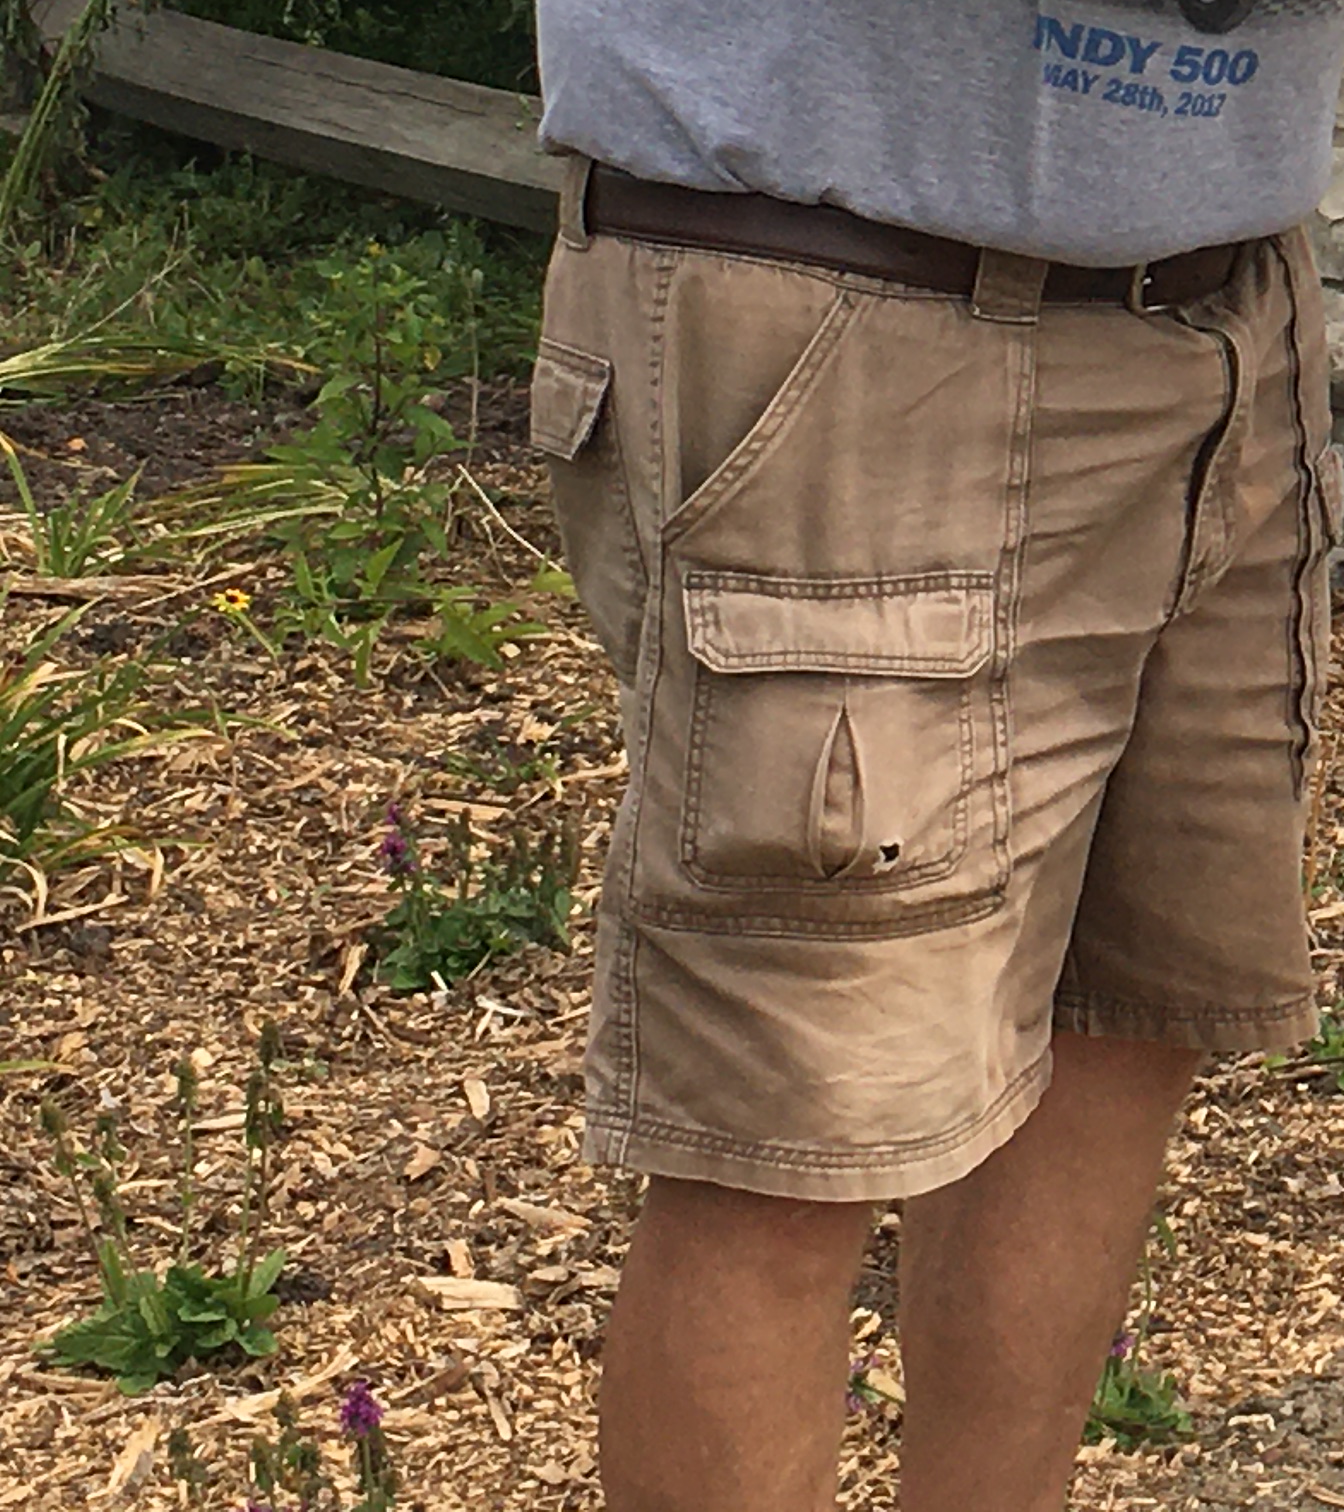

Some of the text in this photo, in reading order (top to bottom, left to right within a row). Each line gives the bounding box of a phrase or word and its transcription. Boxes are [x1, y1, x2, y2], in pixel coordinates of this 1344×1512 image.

[1168, 44, 1259, 86] 500
[1102, 78, 1168, 118] 28th,
[1174, 91, 1227, 118] 2017
